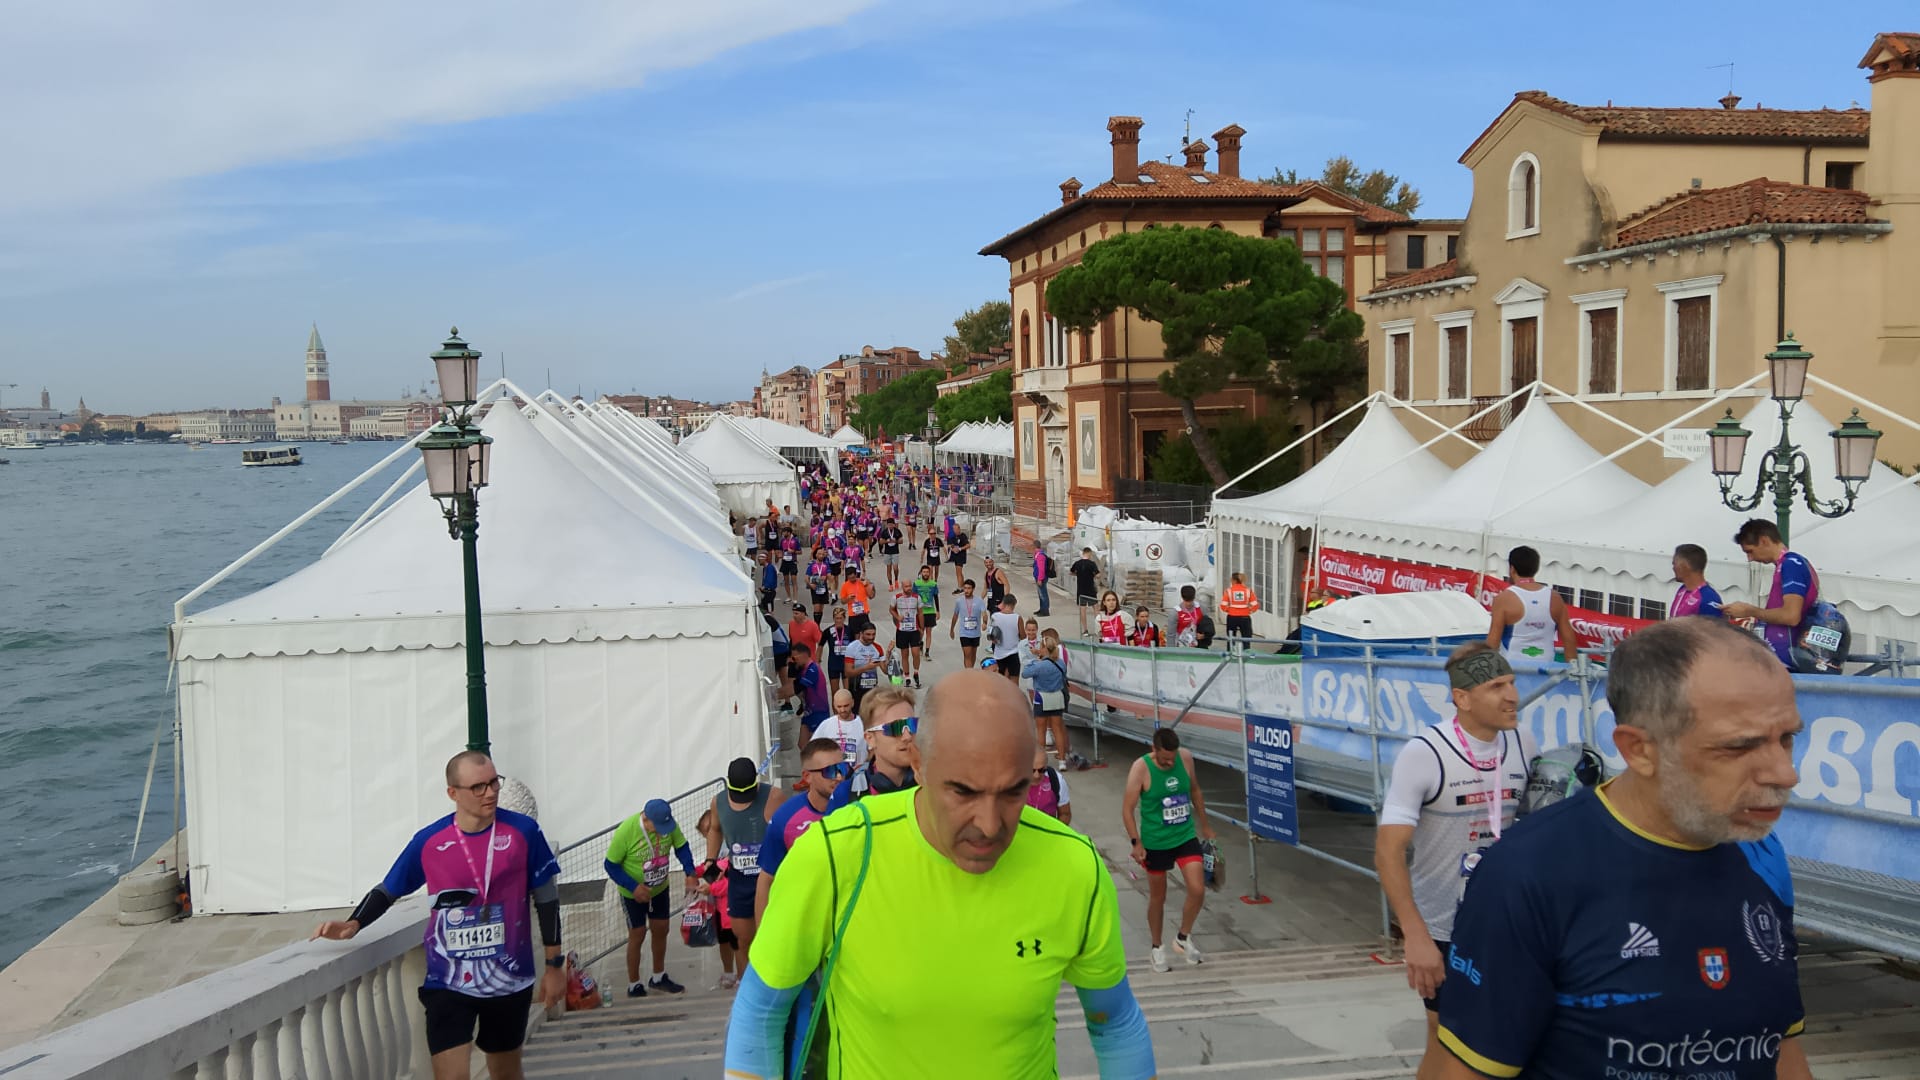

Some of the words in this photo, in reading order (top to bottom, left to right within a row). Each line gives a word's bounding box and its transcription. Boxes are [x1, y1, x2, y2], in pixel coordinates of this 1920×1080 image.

[1360, 564, 1386, 586] Sport
[1810, 632, 1838, 647] 10258
[1254, 725, 1291, 750] PILOSIO
[459, 928, 493, 946] 11412
[1621, 947, 1660, 959] OFFSIDE
